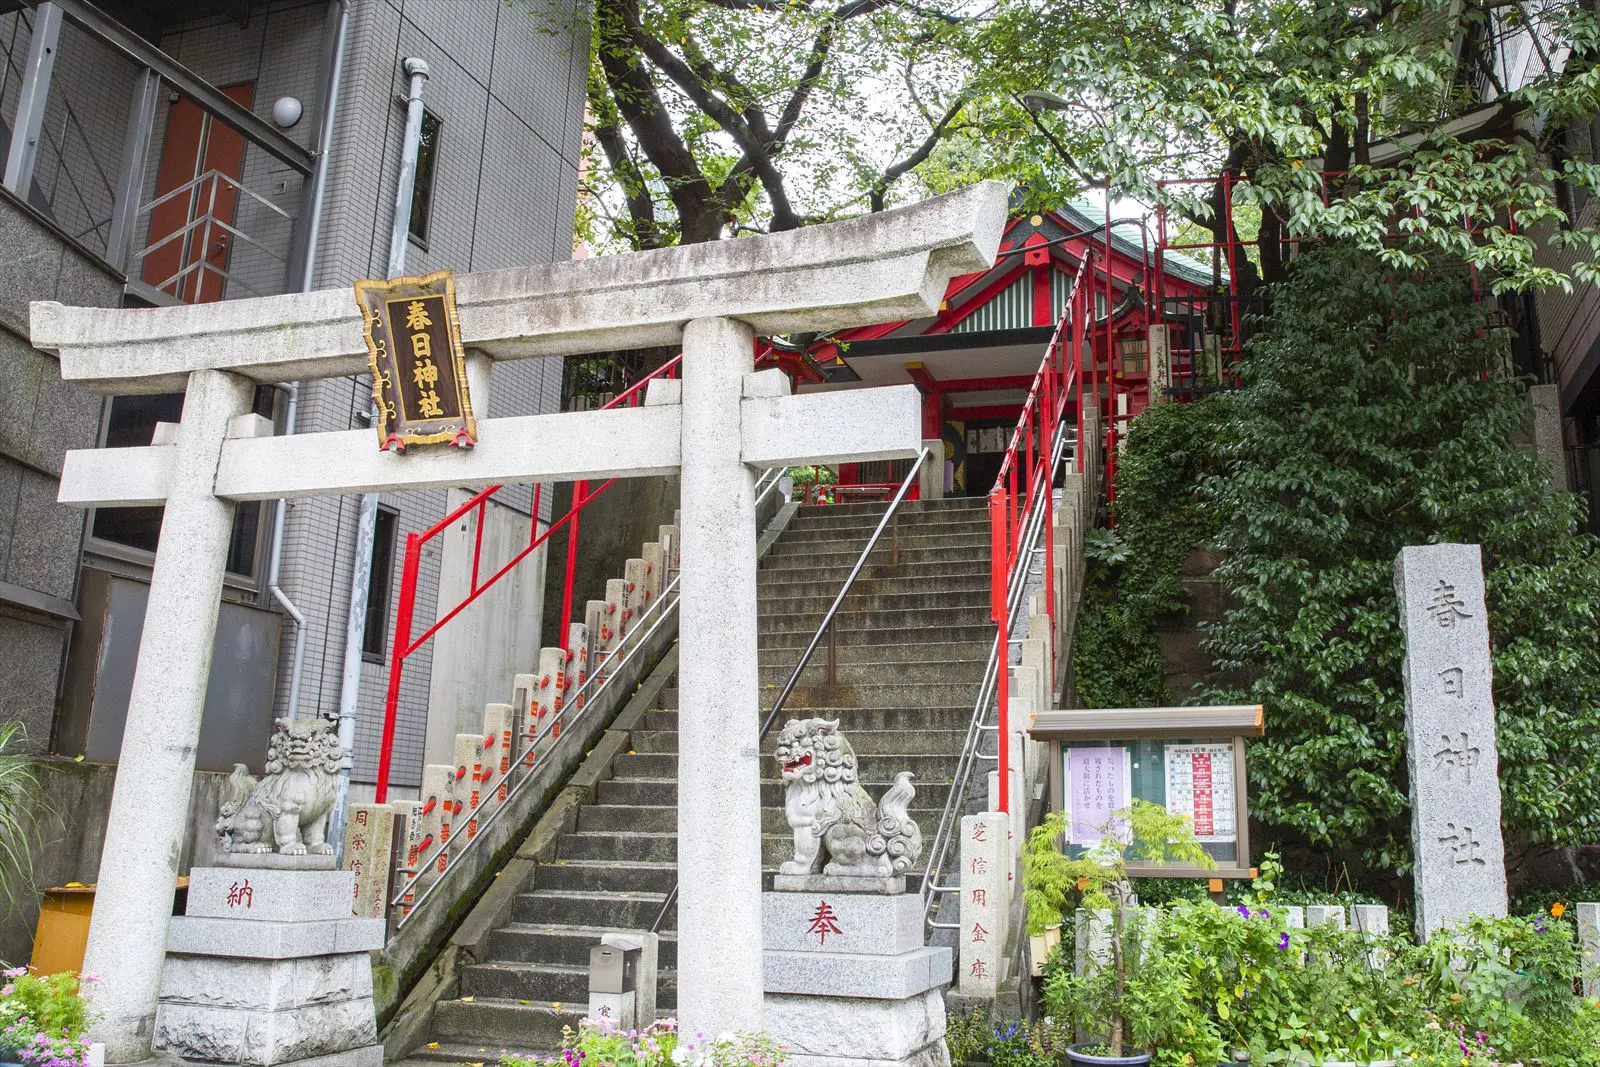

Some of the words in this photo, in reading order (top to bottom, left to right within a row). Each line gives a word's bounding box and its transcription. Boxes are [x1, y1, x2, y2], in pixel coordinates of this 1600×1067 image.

[406, 301, 443, 418] 春日神社
[1426, 579, 1485, 869] 春日神社
[227, 878, 253, 908] 納
[805, 900, 844, 946] 奉
[970, 822, 989, 979] 芝信用金庫
